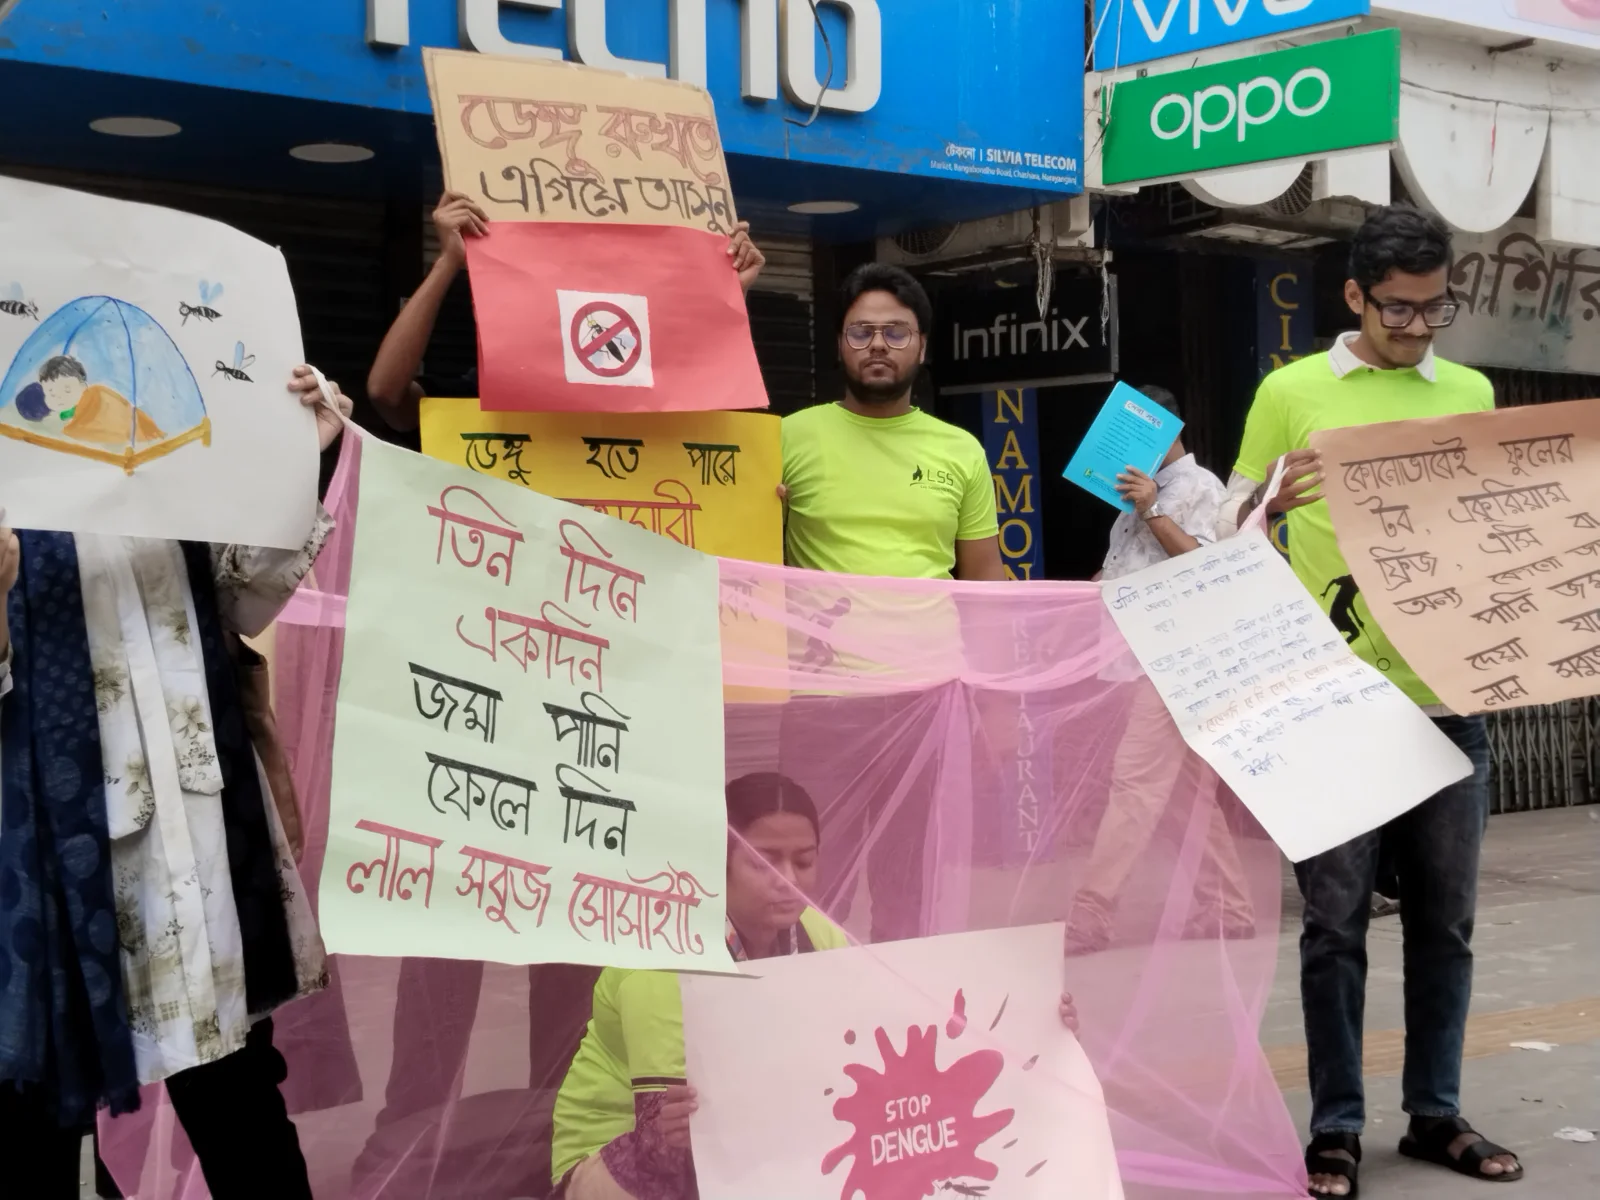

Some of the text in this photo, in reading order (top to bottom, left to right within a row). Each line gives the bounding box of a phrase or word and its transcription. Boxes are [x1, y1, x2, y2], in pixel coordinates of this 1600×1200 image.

[457, 94, 721, 184] ডেঙ্গু রুখতে
[1150, 67, 1331, 149] oppo
[986, 149, 1077, 171] SILVIA TELECOM
[480, 158, 732, 235] এগিয়ে আসুন
[953, 308, 1090, 360] Infinix
[460, 433, 741, 485] ডেঙ্গু হতে পারে
[927, 469, 953, 486] LSS
[1498, 433, 1575, 477] ফুলের
[427, 485, 526, 586] তিন
[559, 519, 645, 623] দিনে
[1470, 588, 1539, 624] পানি
[456, 601, 609, 692] একদিন
[408, 661, 631, 773] জমা পানি
[424, 752, 637, 857] ফেলে দিন
[346, 819, 445, 909] লাল
[455, 845, 552, 934] সবুজ
[885, 1094, 932, 1122] STOP
[871, 1116, 959, 1167] DENGUE
